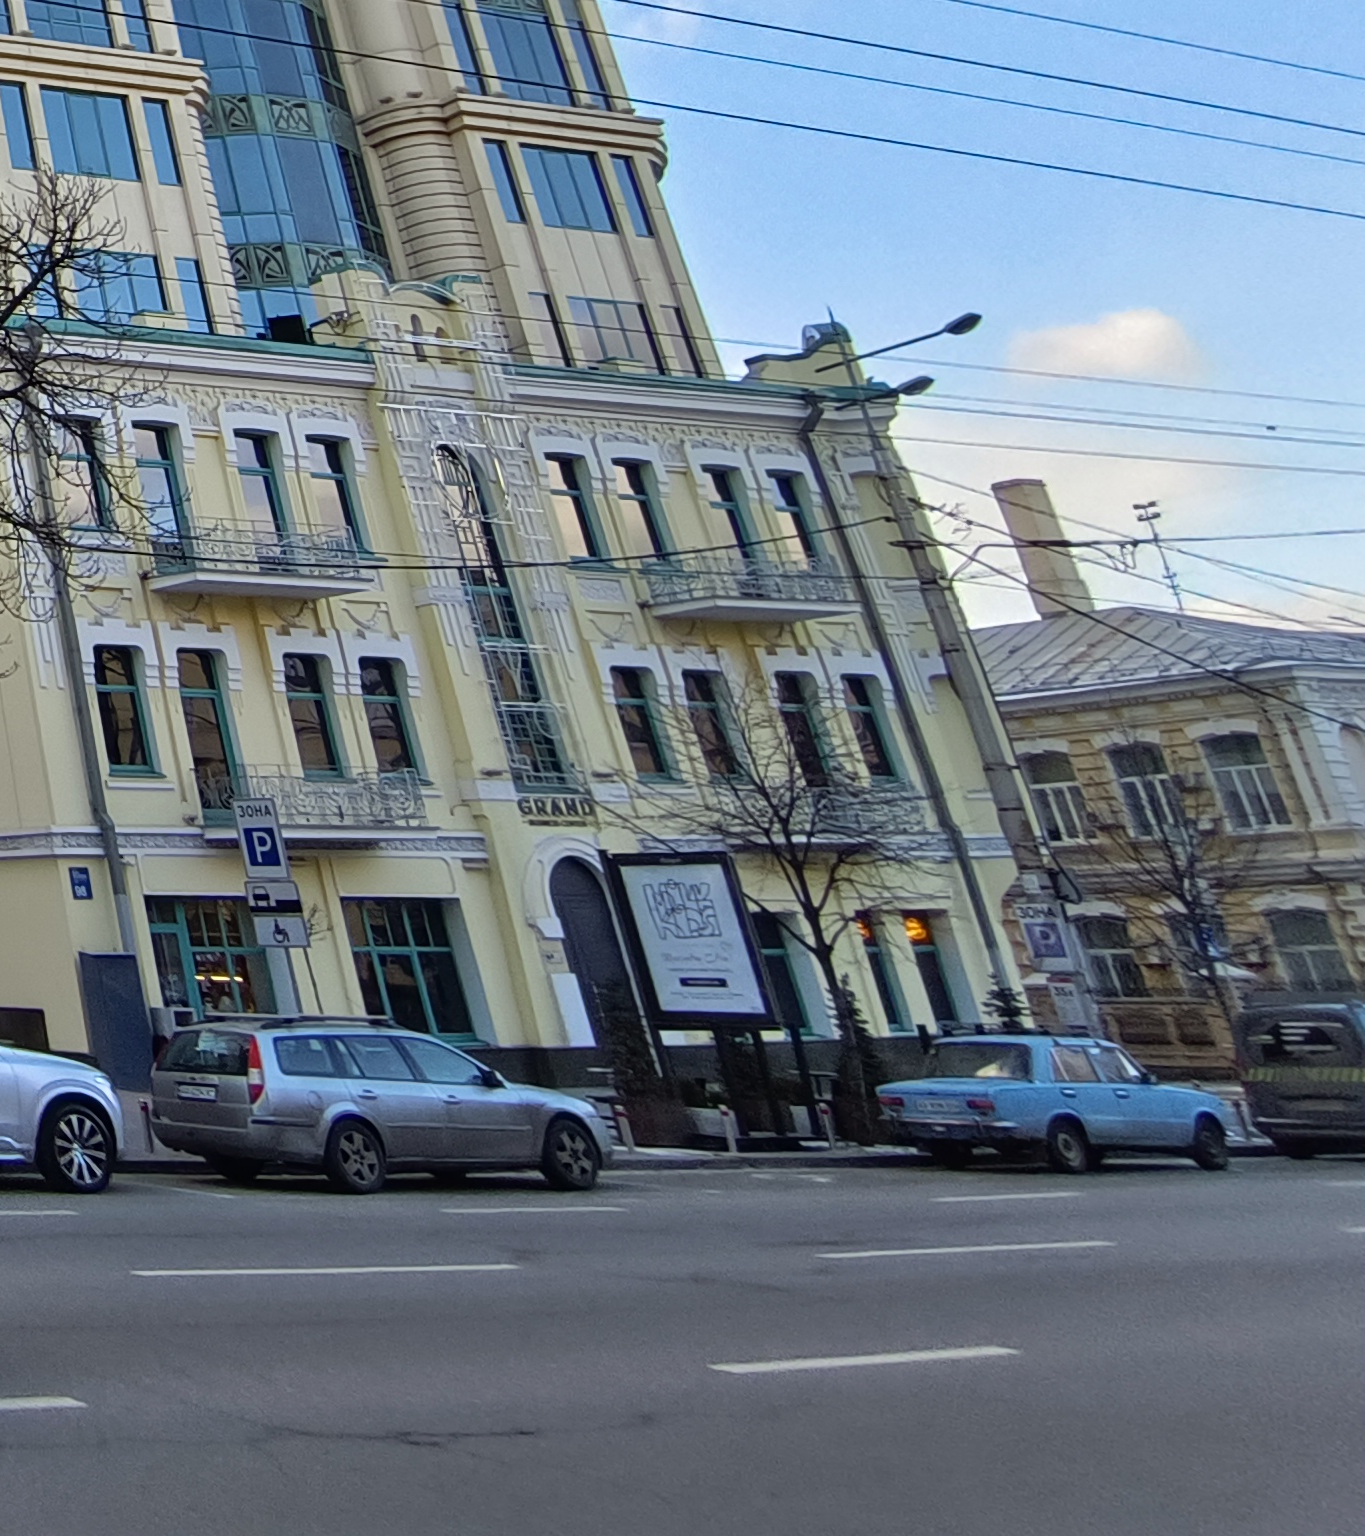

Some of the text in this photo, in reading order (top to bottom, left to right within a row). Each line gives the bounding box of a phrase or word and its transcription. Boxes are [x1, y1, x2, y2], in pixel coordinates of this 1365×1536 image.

[237, 805, 272, 818] ЗОНА
[517, 797, 595, 816] GRAND
[252, 831, 272, 863] P
[1016, 906, 1056, 919] ЗОНА
